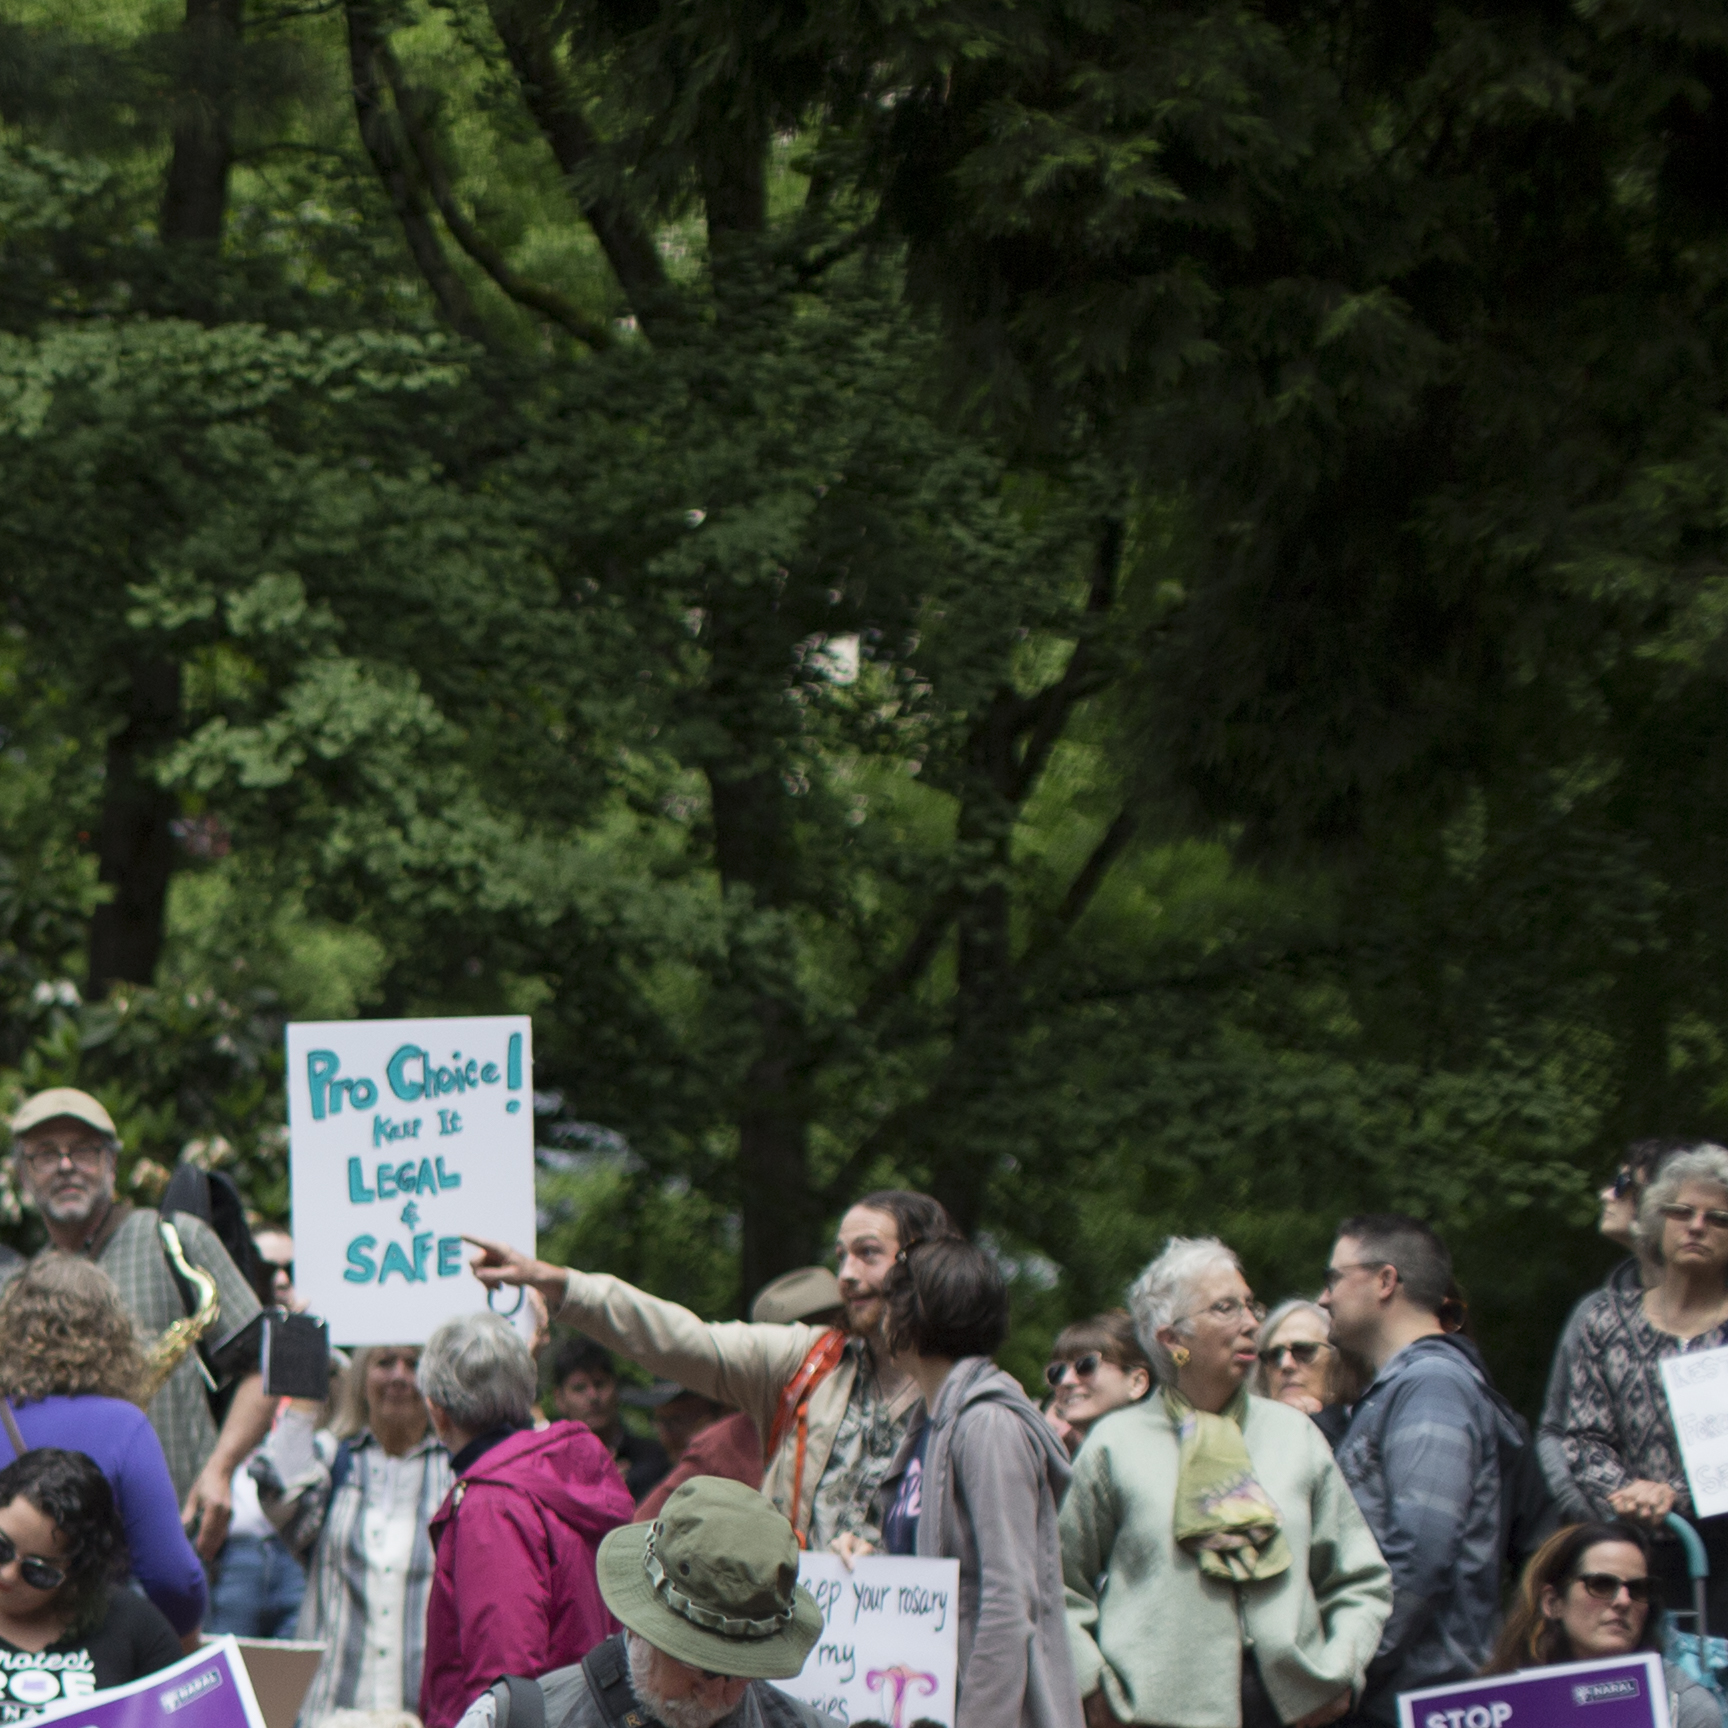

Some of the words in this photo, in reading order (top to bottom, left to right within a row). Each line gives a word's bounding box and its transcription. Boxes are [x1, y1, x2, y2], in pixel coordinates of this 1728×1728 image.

[307, 1049, 379, 1120] Pro
[386, 1031, 523, 1114] Choice!
[437, 1108, 463, 1136] It
[348, 1156, 462, 1204] LEGAL
[400, 1201, 421, 1230] &
[344, 1232, 464, 1284] SAFE
[853, 1582, 892, 1625] your
[899, 1585, 949, 1633] rosary
[818, 1644, 856, 1684] my
[1594, 1681, 1636, 1697] NARAL
